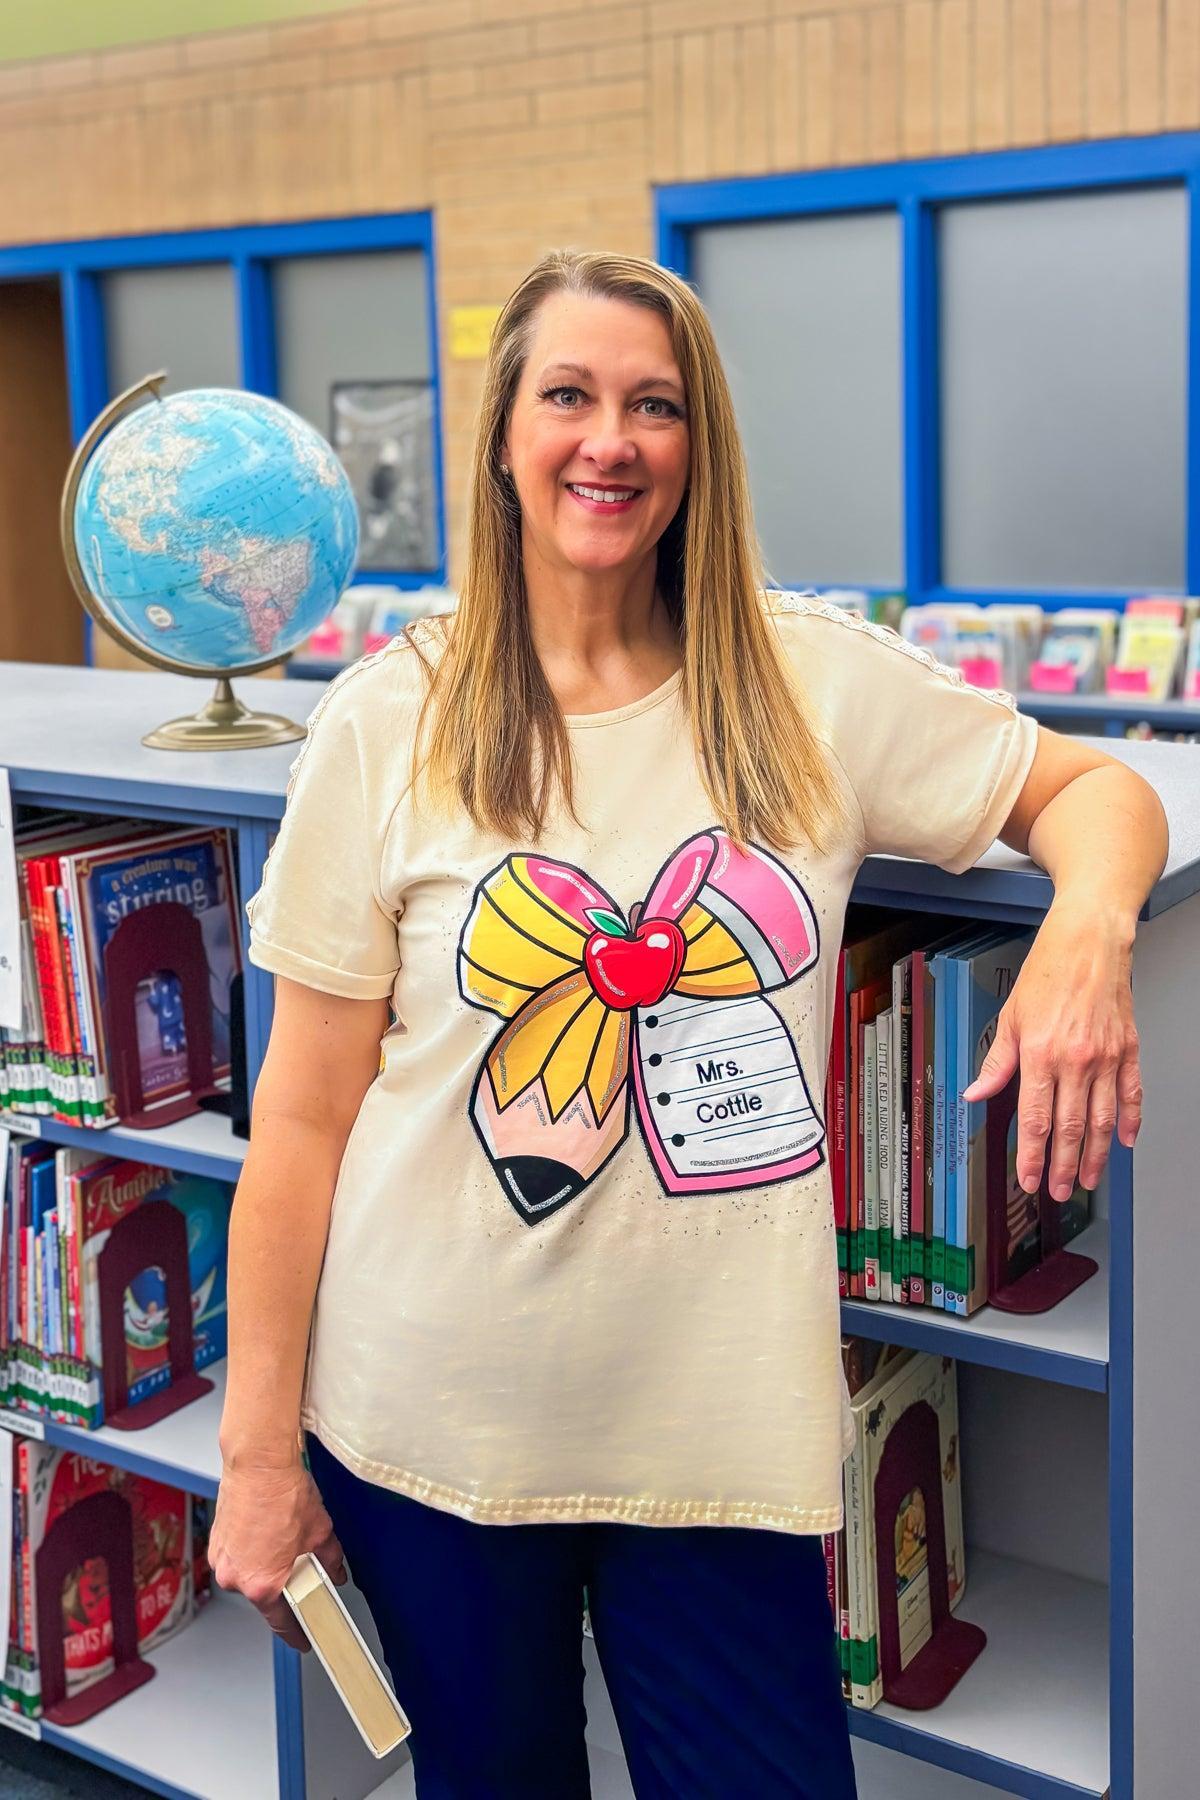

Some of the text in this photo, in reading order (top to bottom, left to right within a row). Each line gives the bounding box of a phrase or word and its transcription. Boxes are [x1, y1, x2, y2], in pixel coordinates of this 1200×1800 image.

[695, 1059, 744, 1085] Mrs.
[696, 1093, 763, 1124] Cottle
[836, 1097, 844, 1110] Red
[878, 1042, 889, 1170] LITTLE RED RIDING HOOD
[836, 1111, 844, 1133] Riding
[913, 1096, 922, 1140] Cinderella
[935, 1083, 944, 1158] The Three Little Pigs
[836, 1134, 844, 1151] Hood
[948, 1160, 956, 1175] Pigs
[957, 1150, 965, 1166] Pigs
